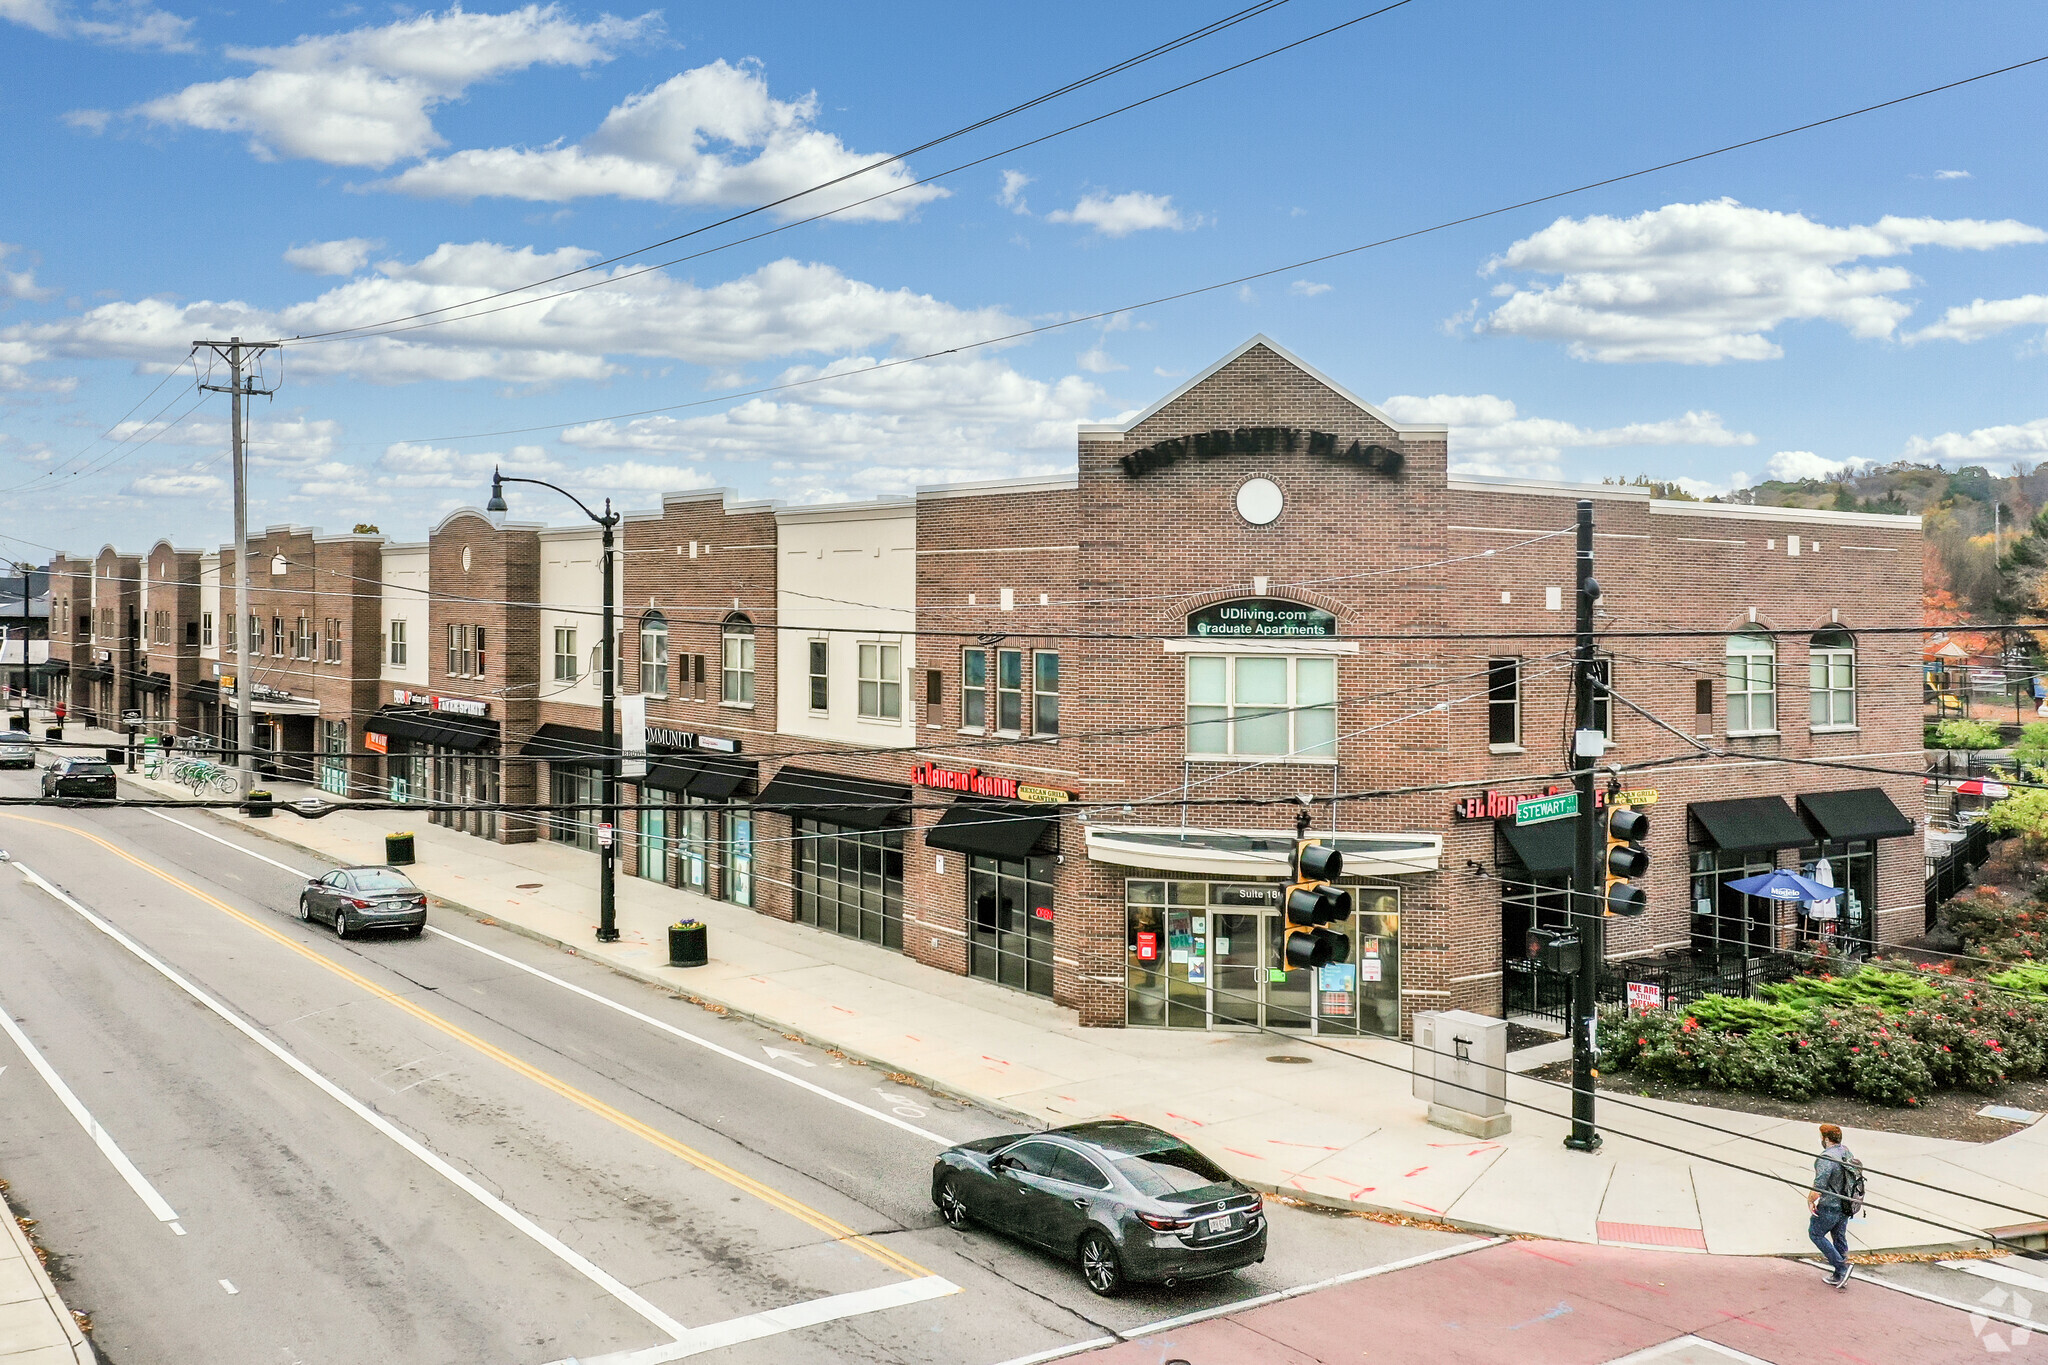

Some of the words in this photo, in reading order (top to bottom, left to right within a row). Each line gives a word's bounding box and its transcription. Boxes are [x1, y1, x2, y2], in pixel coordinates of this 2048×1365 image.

[1220, 608, 1306, 622] UDliving.com
[1197, 622, 1252, 634] Graduate
[1255, 623, 1326, 637] Apartments
[645, 726, 694, 749] OMMUNITY
[911, 766, 926, 785] EL
[925, 761, 969, 792] RANCHO
[970, 768, 1017, 799] GRANDE
[1020, 786, 1047, 796] MEXICAN
[1047, 790, 1068, 799] GRILL
[1466, 798, 1485, 818] EL
[1487, 790, 1545, 818] RAN
[1523, 800, 1566, 819] STEWART
[1239, 889, 1263, 899] Suite
[1770, 888, 1800, 897] Modelo
[1629, 984, 1642, 993] WE
[1643, 985, 1658, 996] ARE
[1636, 993, 1651, 1001] STILL
